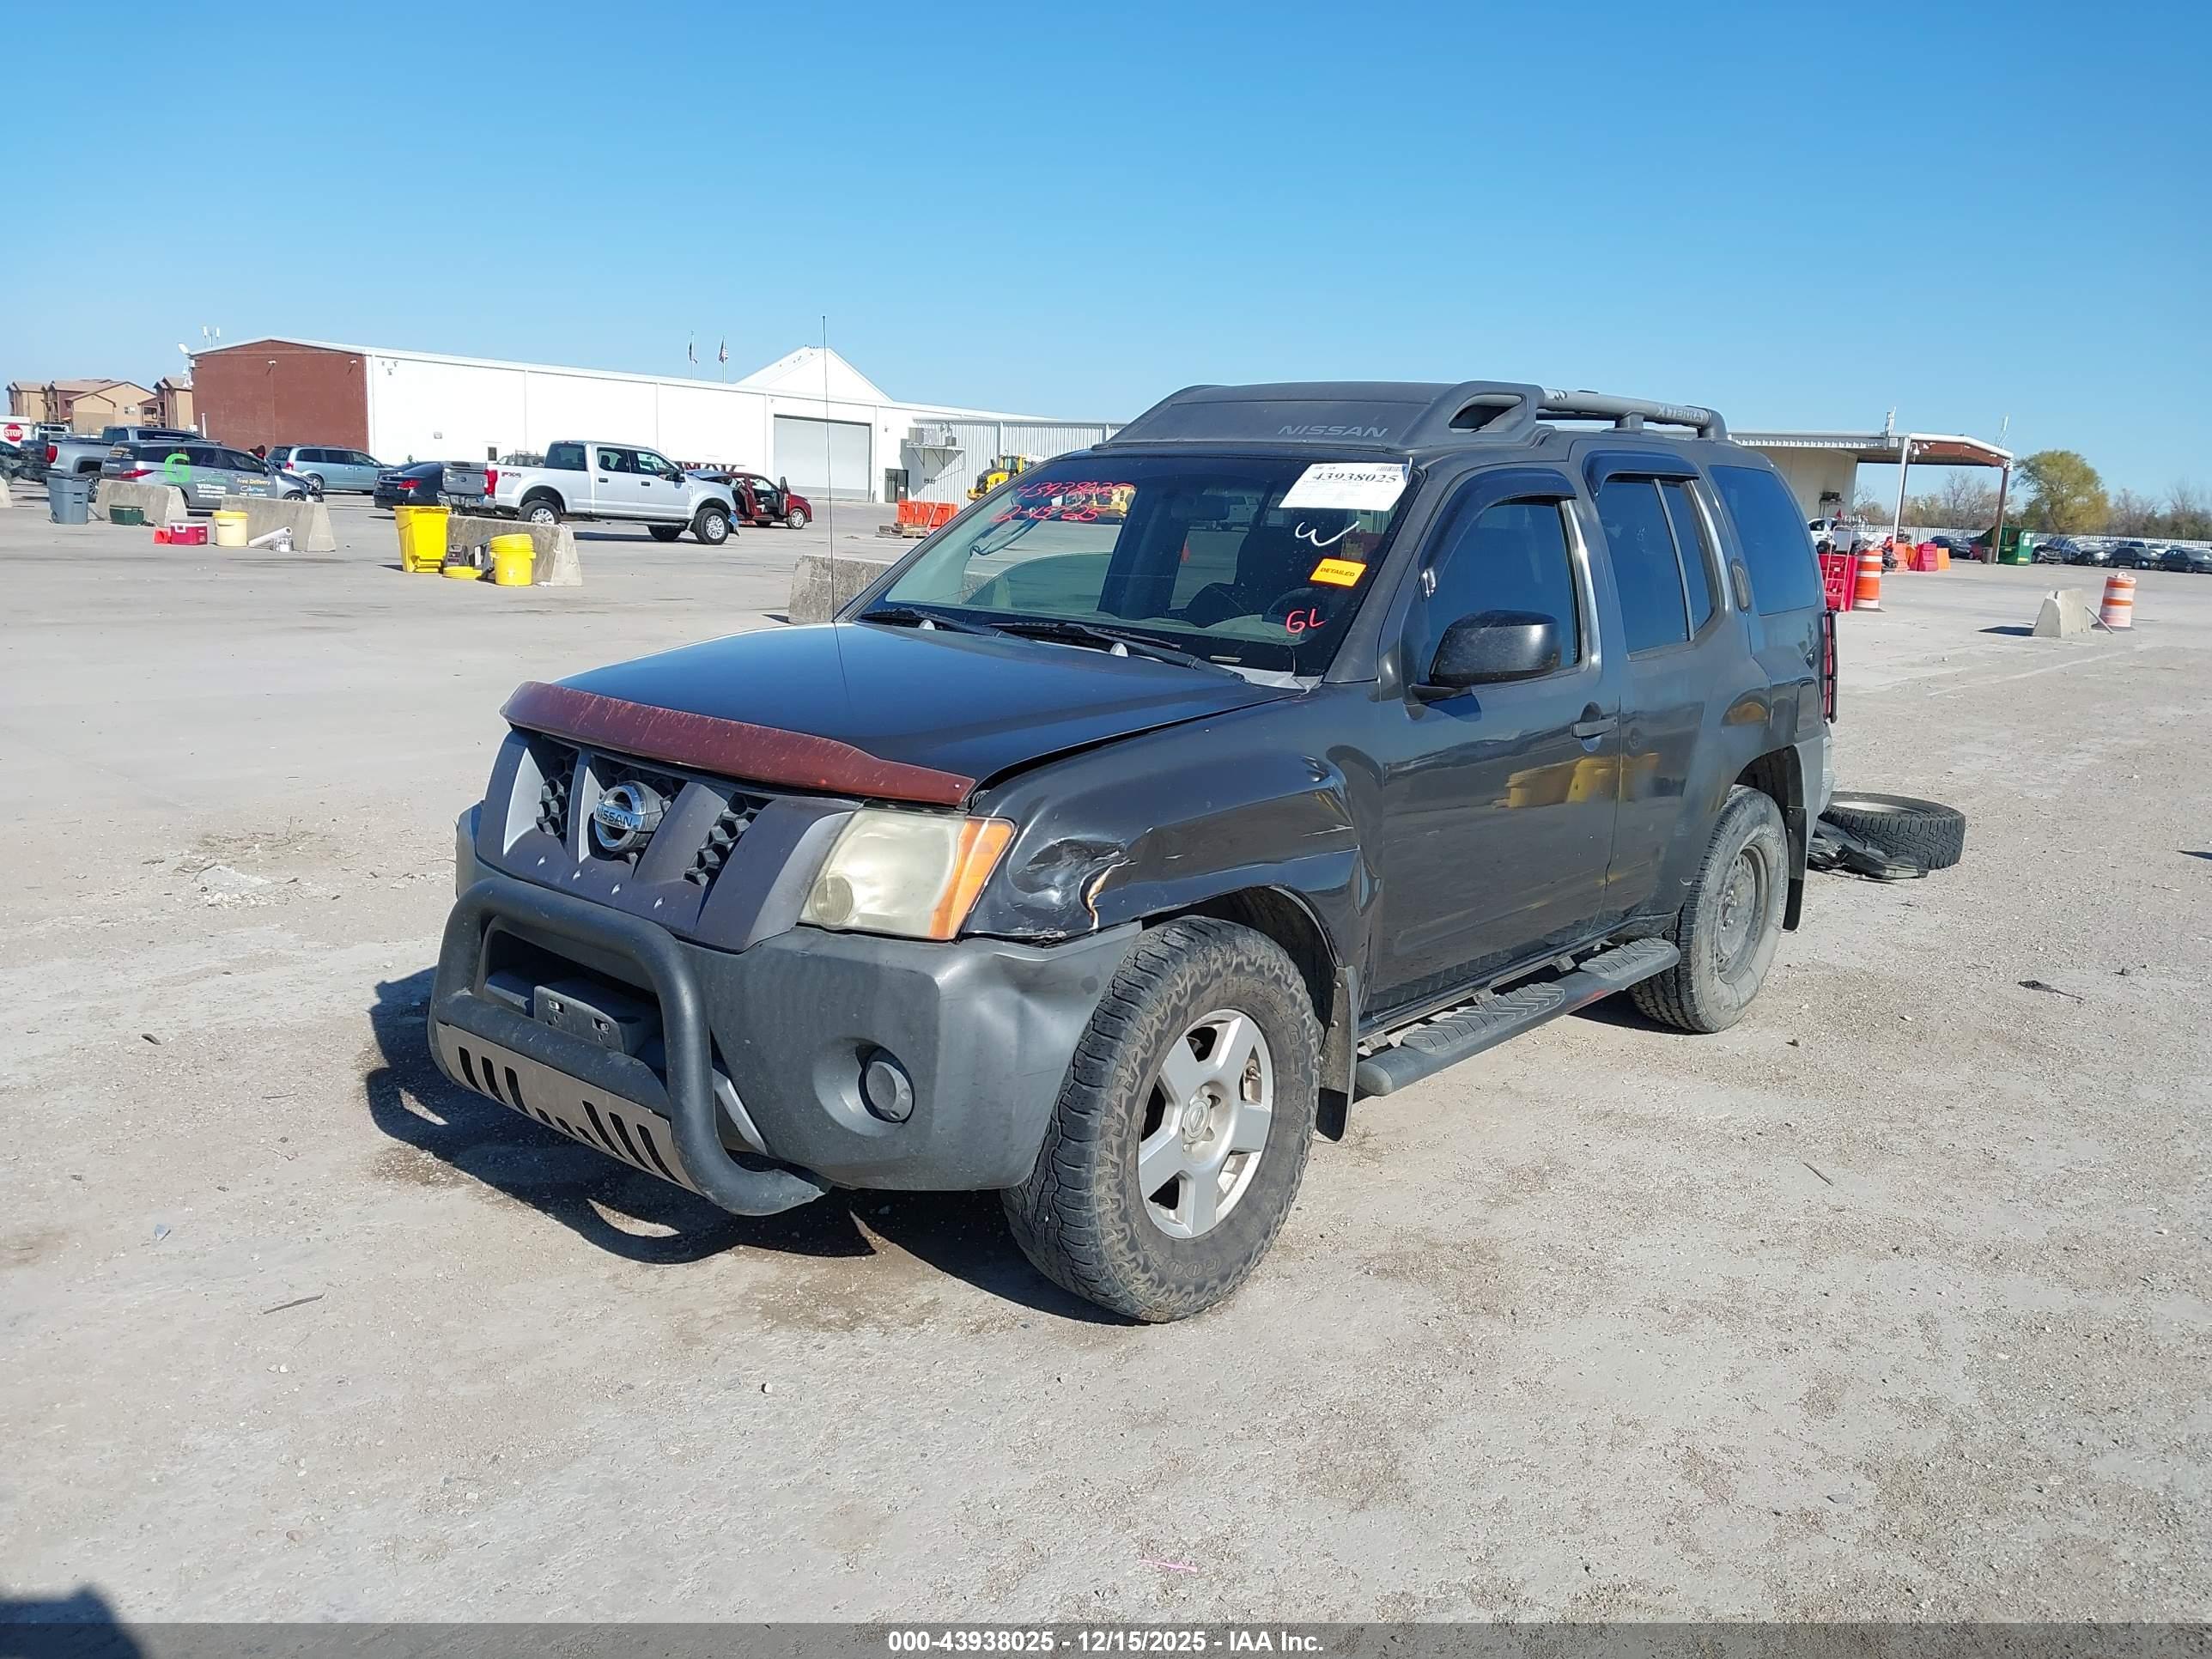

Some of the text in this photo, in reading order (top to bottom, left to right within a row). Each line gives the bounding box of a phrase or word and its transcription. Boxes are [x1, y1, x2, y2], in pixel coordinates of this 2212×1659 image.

[4, 428, 22, 437] STOP
[1278, 425, 1389, 438] NISSAN
[1312, 471, 1399, 483] 43938025
[1320, 567, 1355, 577] DETAILED
[596, 807, 633, 827] NISSAN
